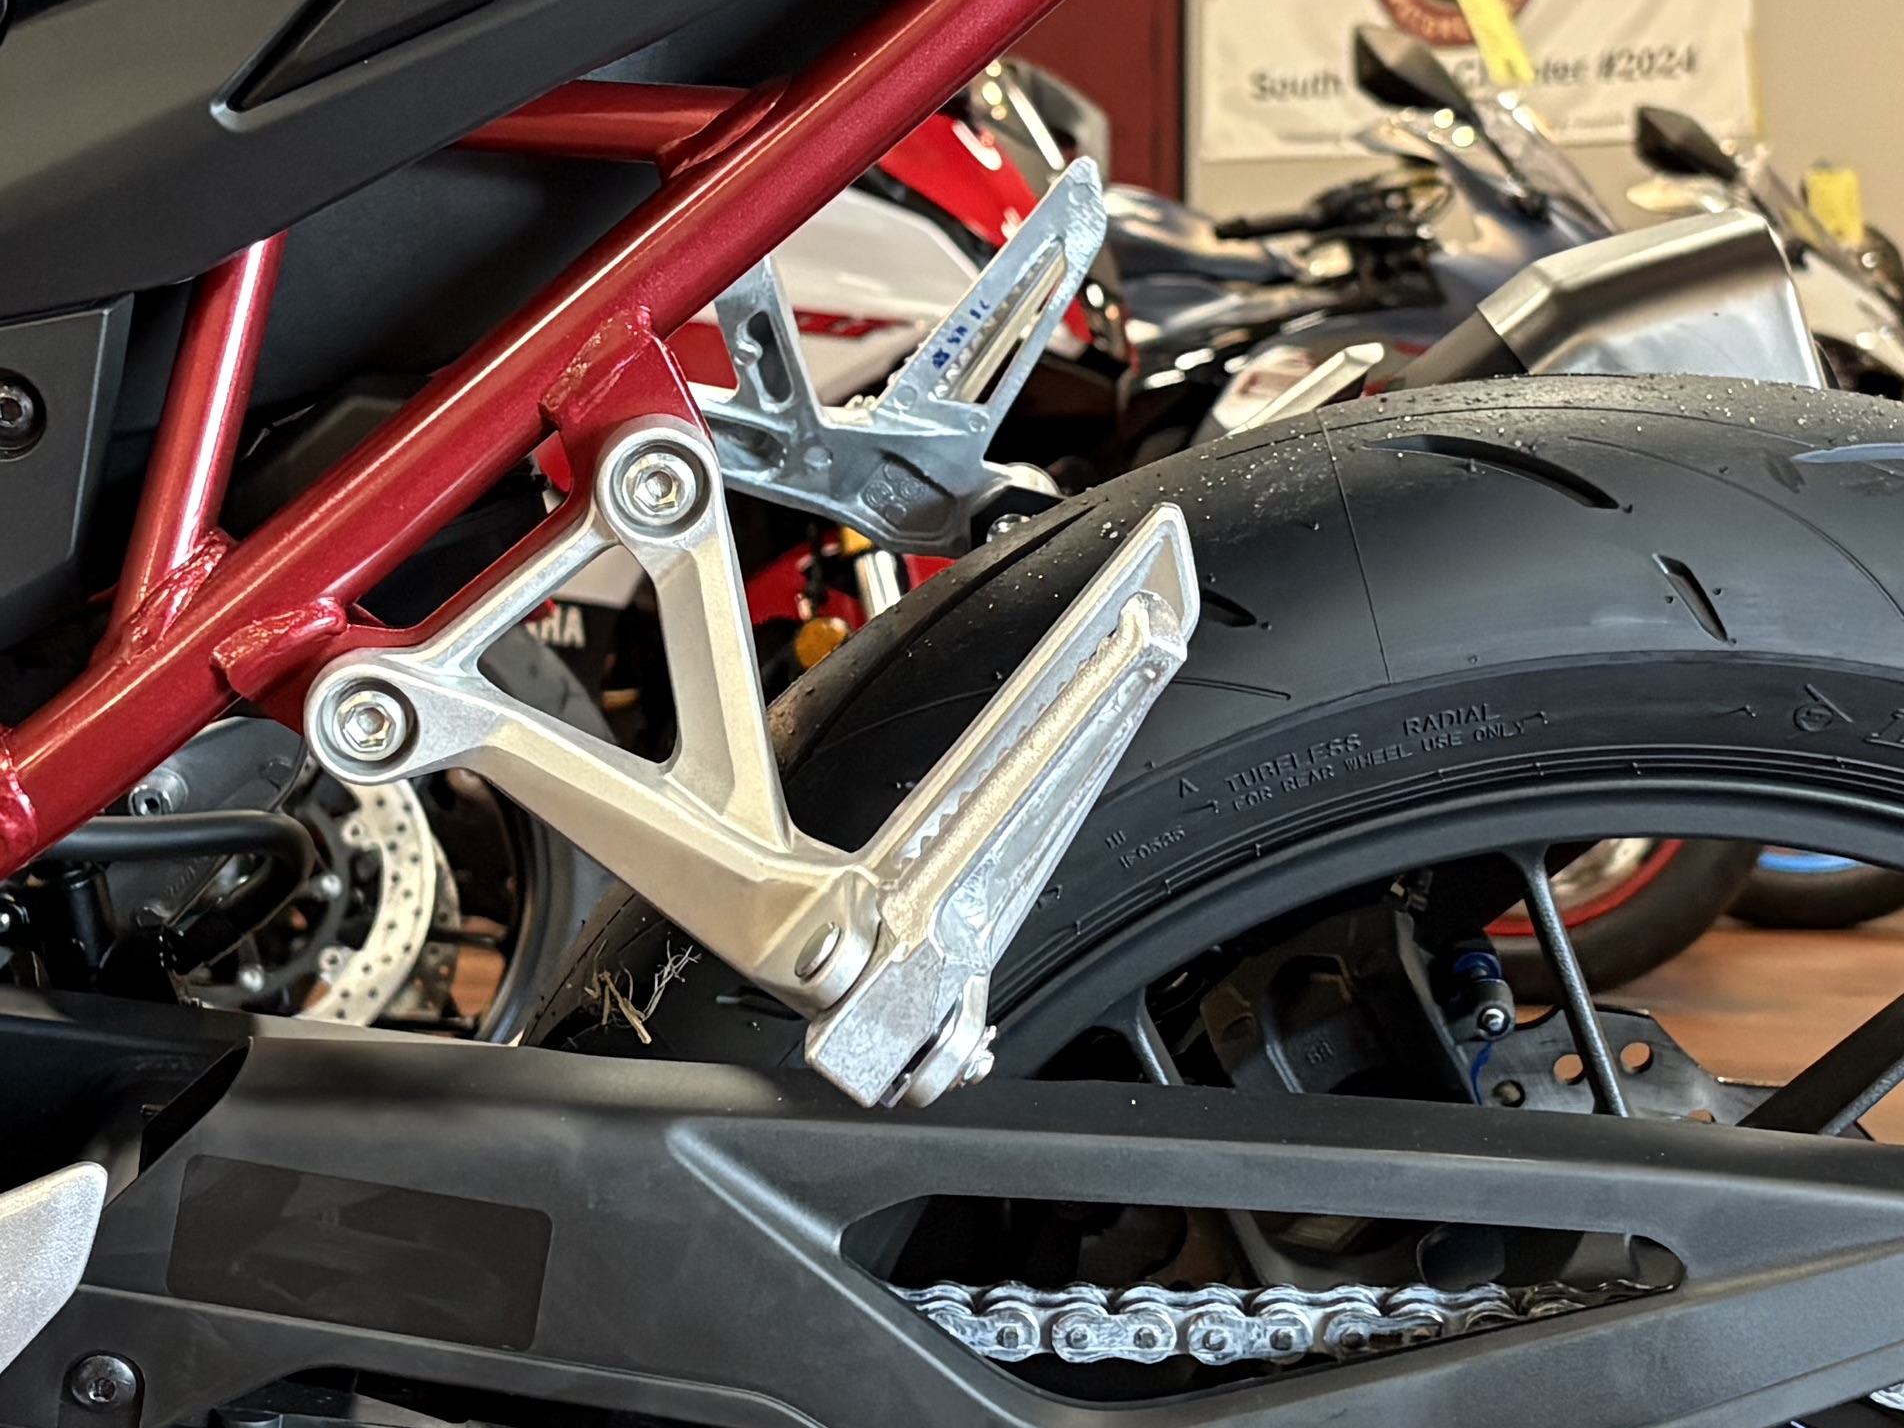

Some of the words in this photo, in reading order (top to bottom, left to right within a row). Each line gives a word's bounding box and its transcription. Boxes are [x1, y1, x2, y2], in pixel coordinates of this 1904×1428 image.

[1250, 68, 1345, 101] South
[1593, 47, 1696, 83] #2024
[1224, 733, 1362, 794] TUBELESS
[1403, 703, 1501, 737] RADIAL
[1234, 785, 1273, 813] FOR
[1280, 764, 1336, 793] REAR
[1345, 740, 1413, 772] WHEEL
[1421, 730, 1463, 753] USE
[1473, 718, 1529, 743] ONLY
